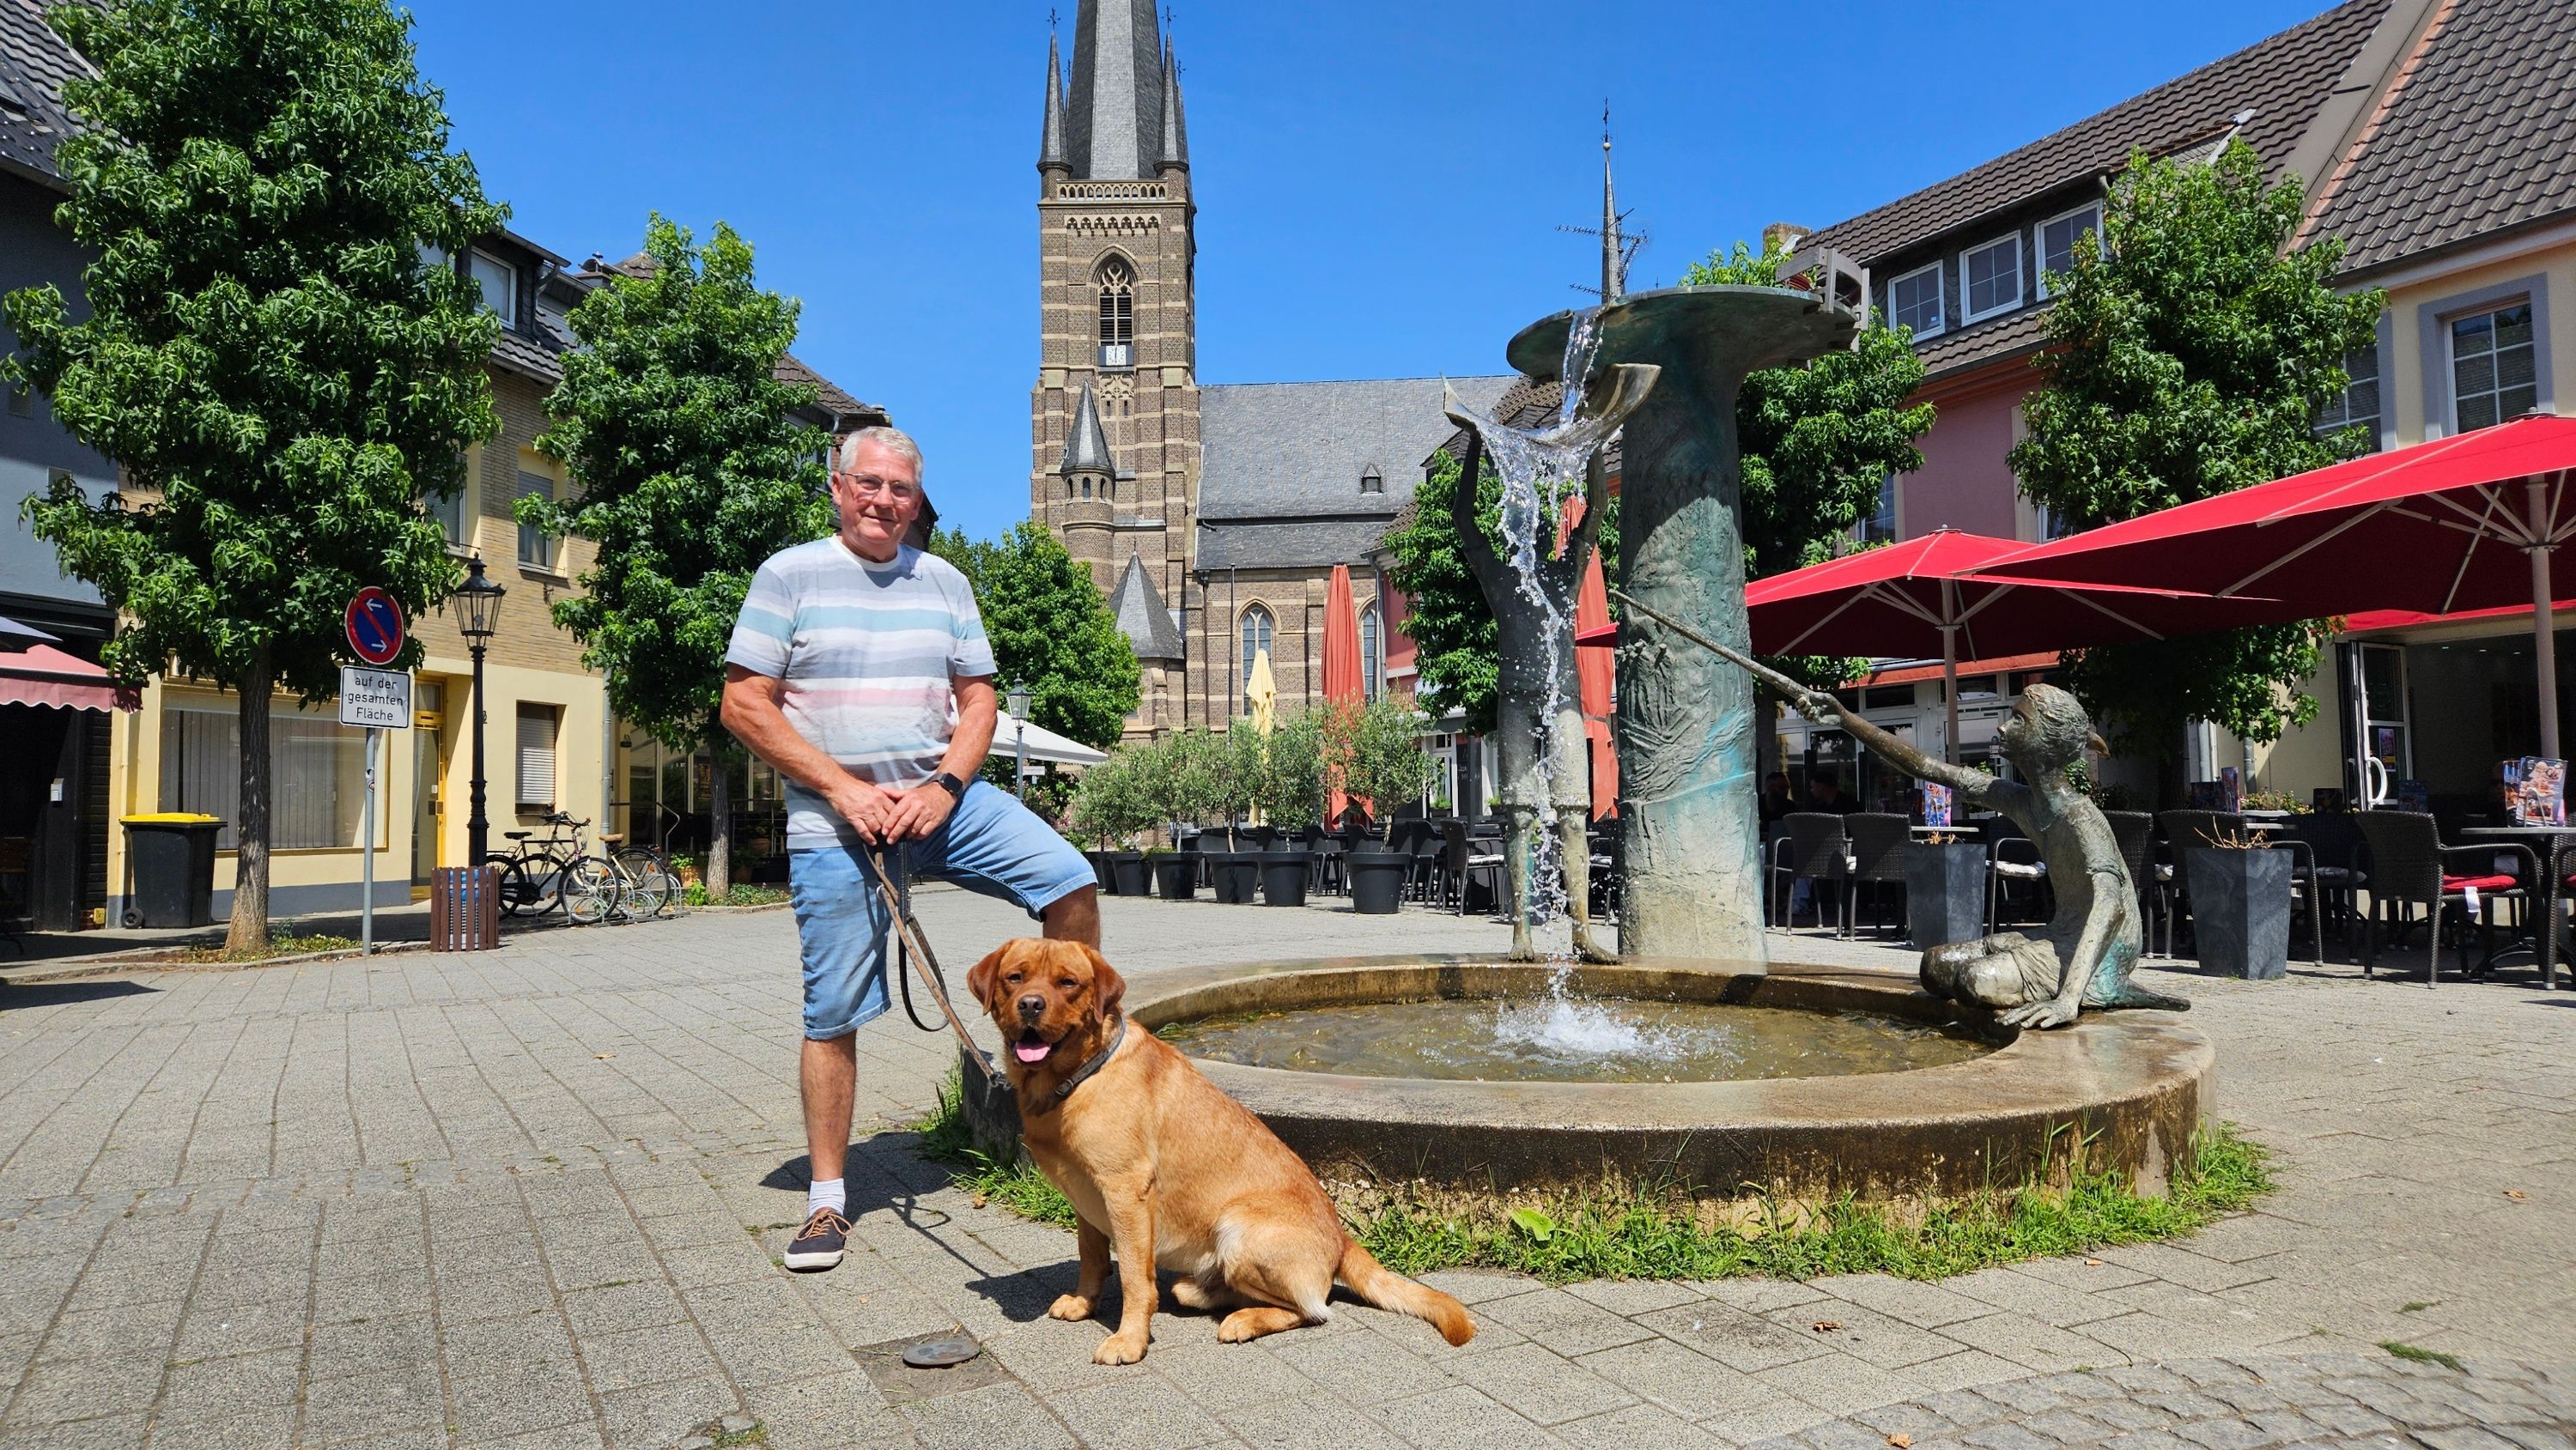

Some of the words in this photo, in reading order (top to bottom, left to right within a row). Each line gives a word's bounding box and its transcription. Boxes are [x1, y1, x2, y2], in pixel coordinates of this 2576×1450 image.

[355, 676, 373, 687] auf
[378, 677, 397, 689] der
[348, 693, 404, 706] gesamten
[356, 707, 393, 720] Fläche
